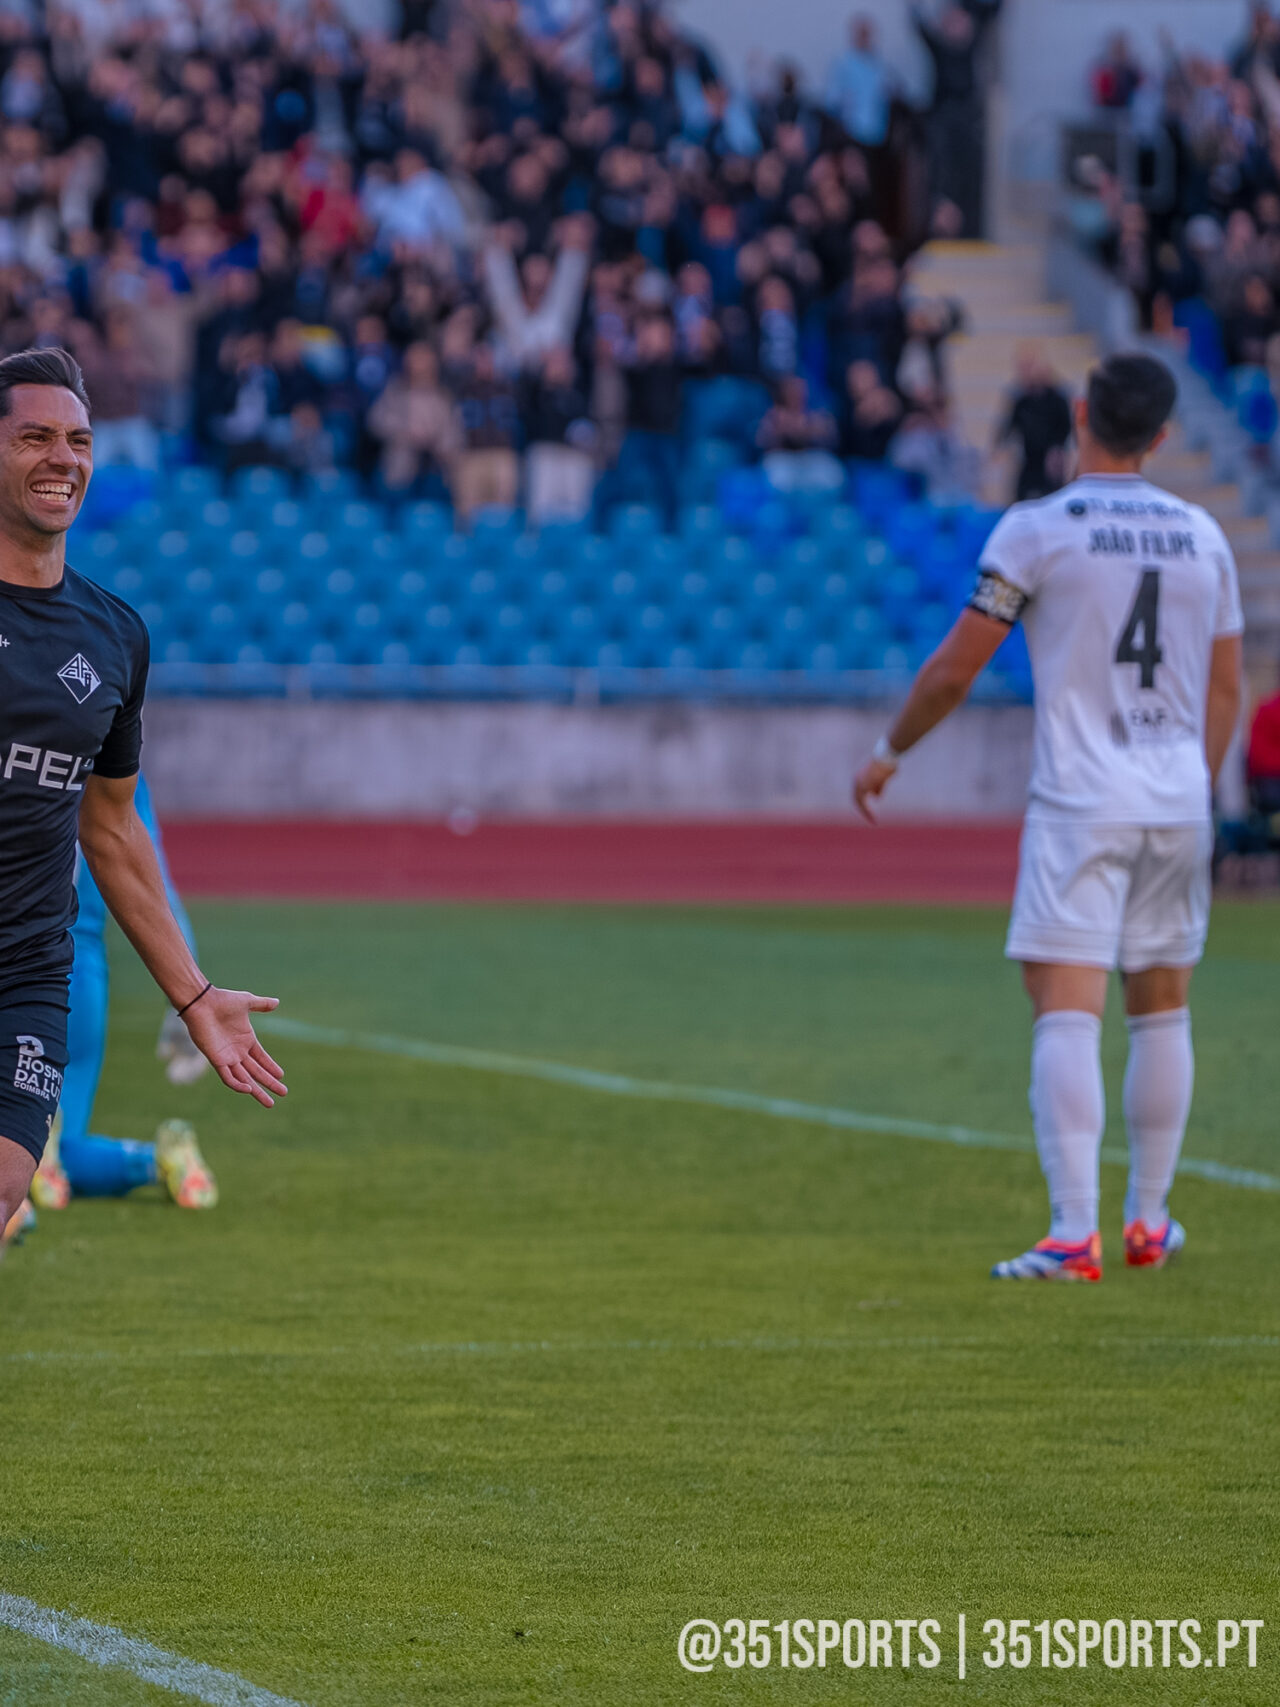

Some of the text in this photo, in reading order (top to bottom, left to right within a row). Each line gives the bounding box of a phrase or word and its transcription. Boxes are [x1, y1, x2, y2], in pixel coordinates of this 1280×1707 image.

[1114, 568, 1164, 690] 4
[14, 1068, 39, 1088] DA
[13, 1080, 50, 1101] COIMBRA
